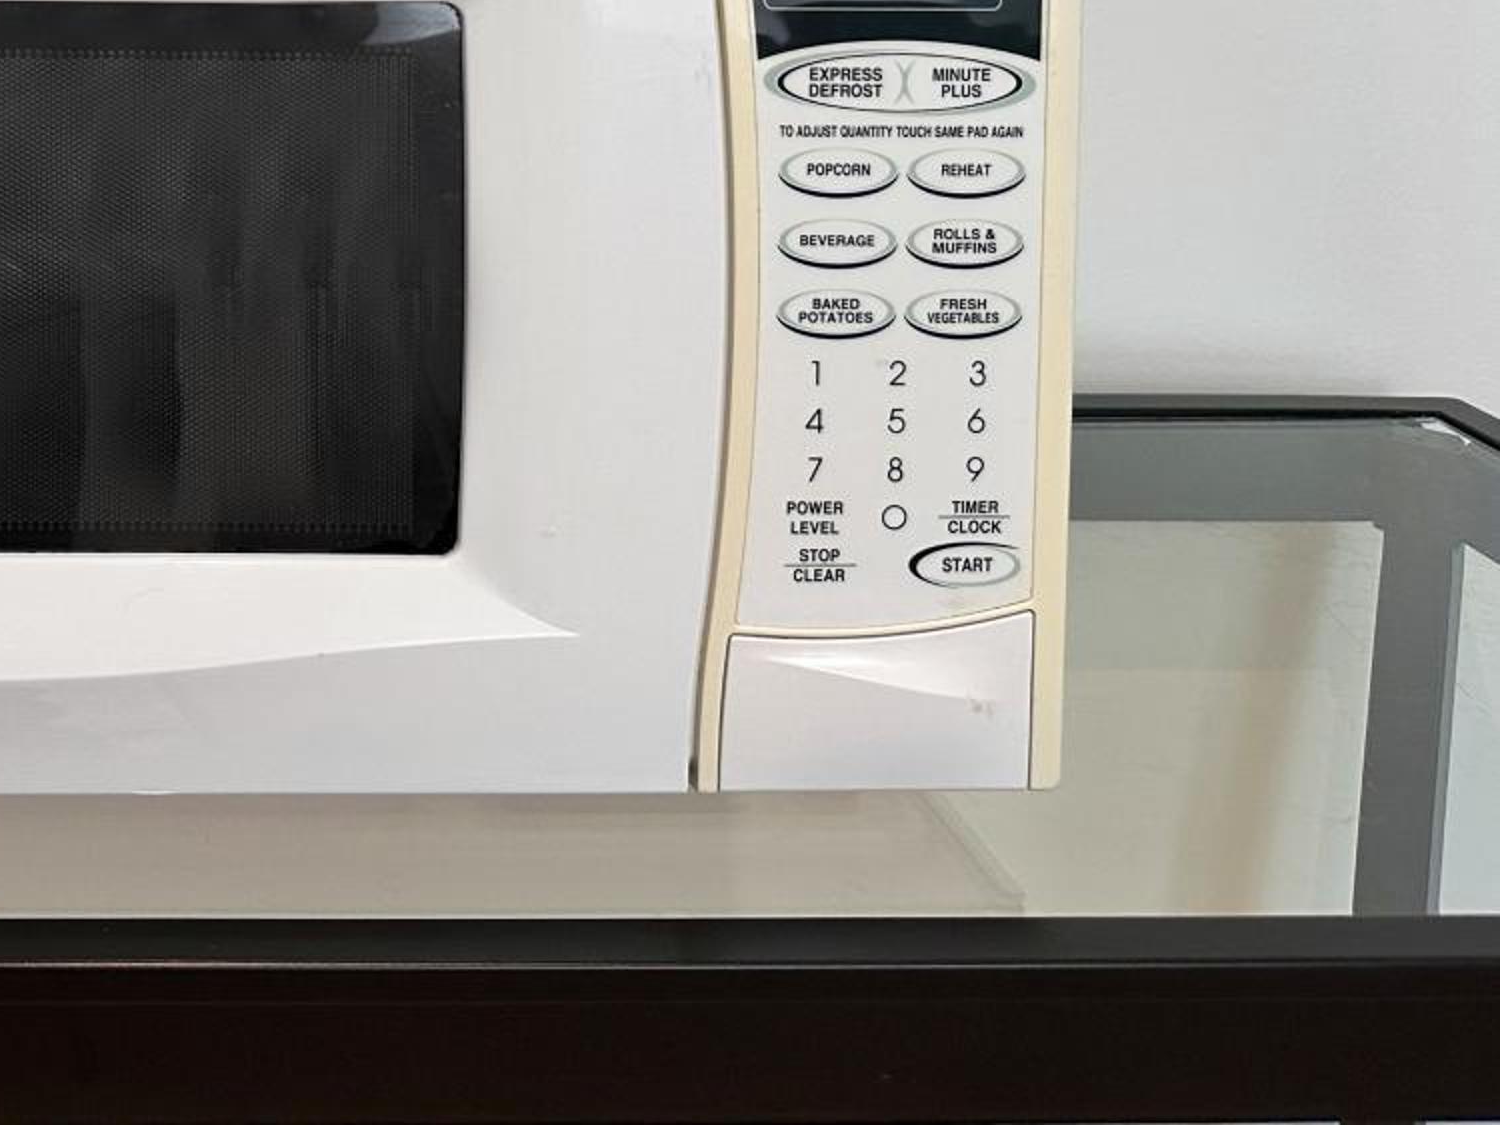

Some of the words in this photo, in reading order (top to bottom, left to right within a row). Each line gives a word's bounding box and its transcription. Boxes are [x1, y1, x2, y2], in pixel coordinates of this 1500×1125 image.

[809, 67, 883, 82] EXPRESS
[932, 68, 991, 82] MINUTE
[809, 82, 883, 98] DEFROST
[941, 83, 982, 98] PLUS
[780, 124, 793, 137] TO
[796, 124, 837, 138] ADJUST
[840, 124, 893, 139] QUANTITY
[896, 125, 932, 139] TOUCH
[935, 125, 964, 139] SAME
[967, 125, 989, 139] PAD
[991, 125, 1024, 139] AGAIN
[806, 163, 871, 177] POPCORN
[941, 163, 991, 177] REHEAT
[799, 234, 875, 248] BEVERAGE
[934, 228, 980, 241] ROLLS
[984, 228, 996, 241] &
[932, 241, 997, 255] MUFFINS
[812, 298, 860, 311] BAKED
[940, 298, 987, 311] FRESH
[798, 311, 873, 325] POTATOES
[927, 311, 1000, 325] VEGETABLES
[810, 360, 821, 386] 1
[889, 360, 907, 387] 2
[969, 360, 987, 387] 3
[805, 408, 825, 435] 4
[887, 408, 906, 435] 5
[967, 408, 986, 434] 6
[807, 456, 823, 483] 7
[887, 456, 904, 483] 8
[966, 456, 985, 483] 9
[786, 500, 844, 516] POWER
[951, 500, 1000, 516] TIMER
[790, 520, 839, 536] LEVEL
[947, 519, 1001, 535] CLOCK
[799, 548, 841, 564] STOP
[942, 557, 993, 573] START
[793, 567, 846, 583] CLEAR
